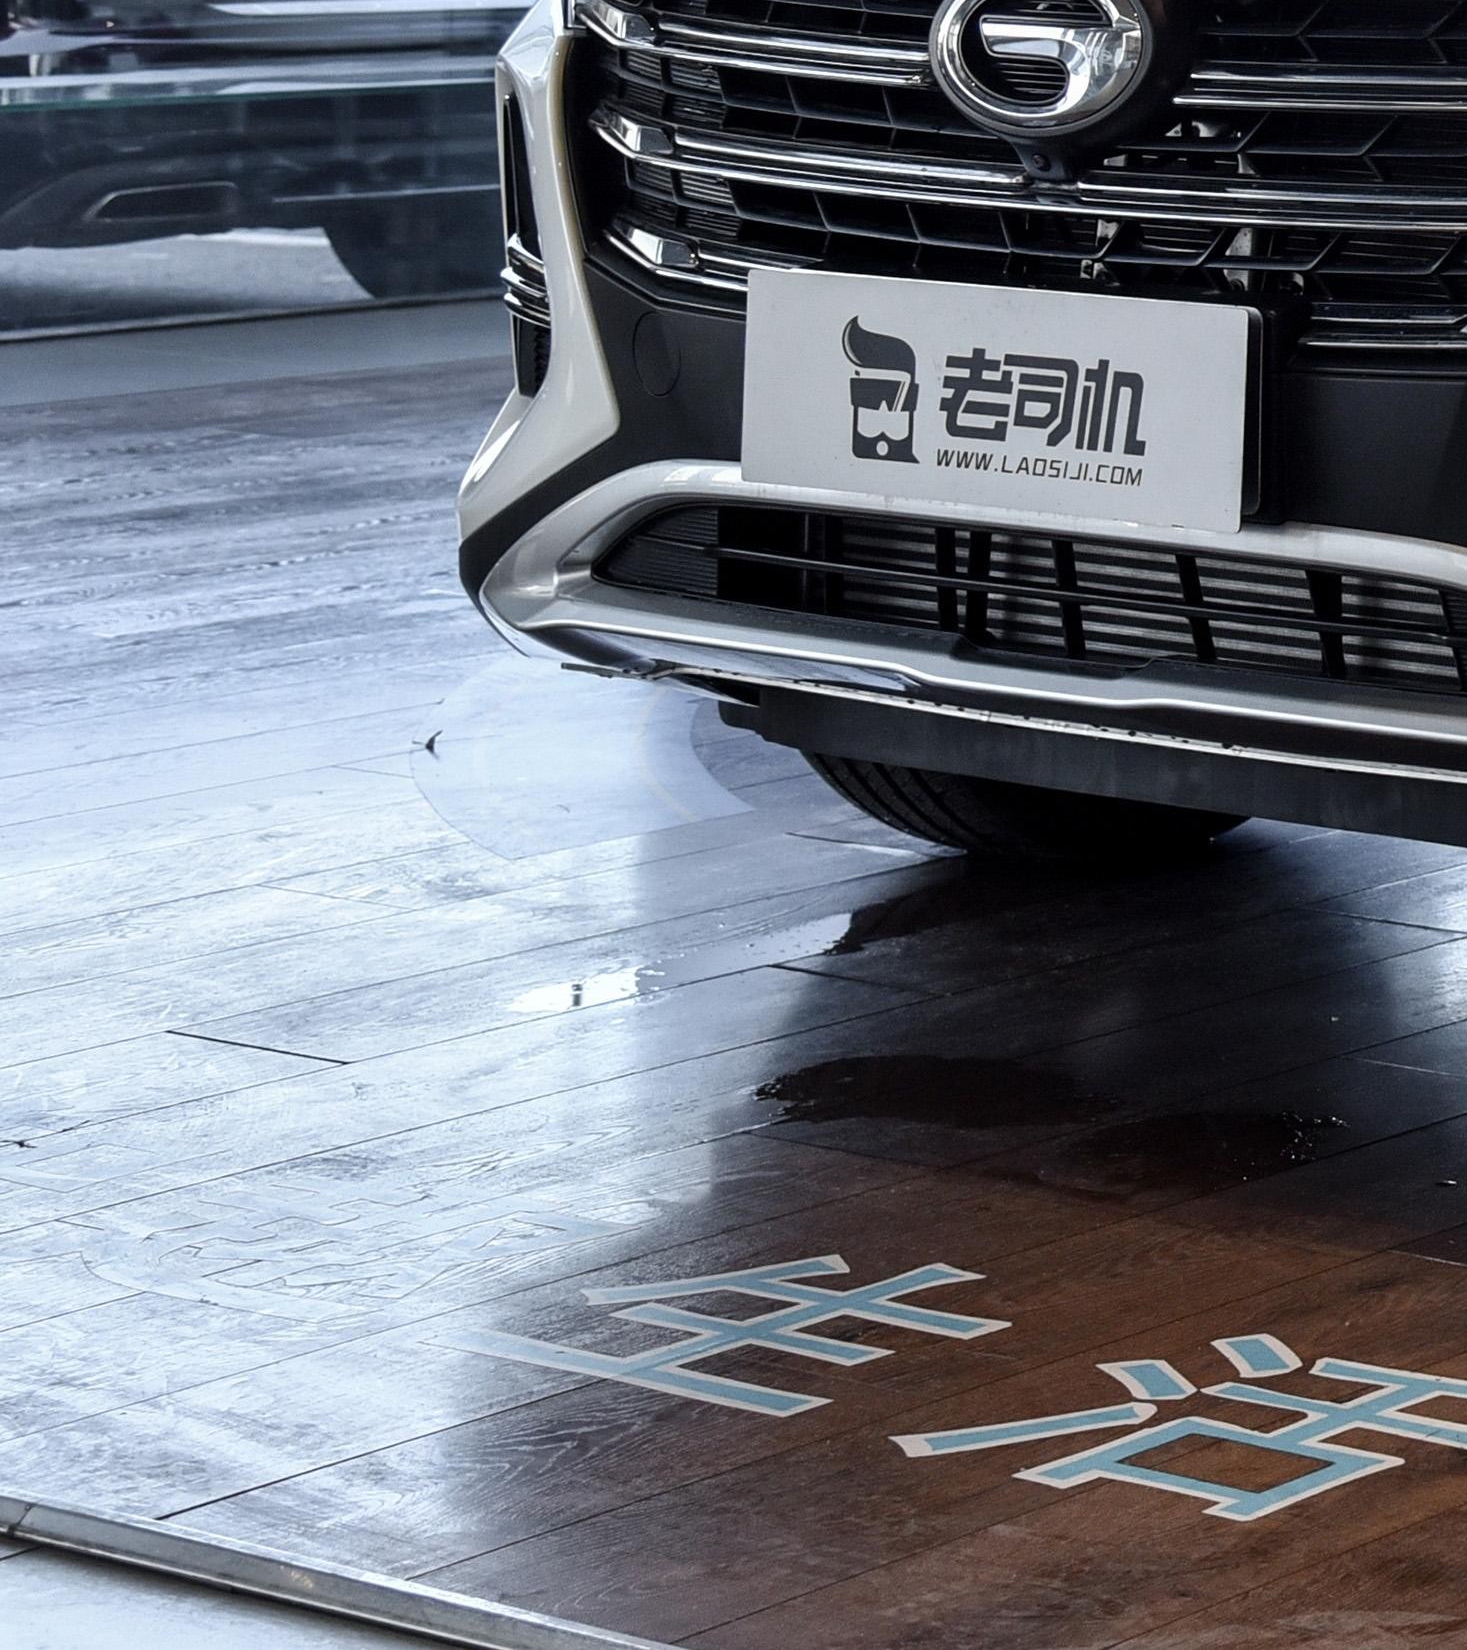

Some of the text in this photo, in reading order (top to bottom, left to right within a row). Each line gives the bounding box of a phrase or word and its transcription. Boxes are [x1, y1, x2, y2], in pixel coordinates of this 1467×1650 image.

[938, 347, 1147, 457] 老司机
[936, 448, 1144, 487] WWW.LAOSIJI.COM
